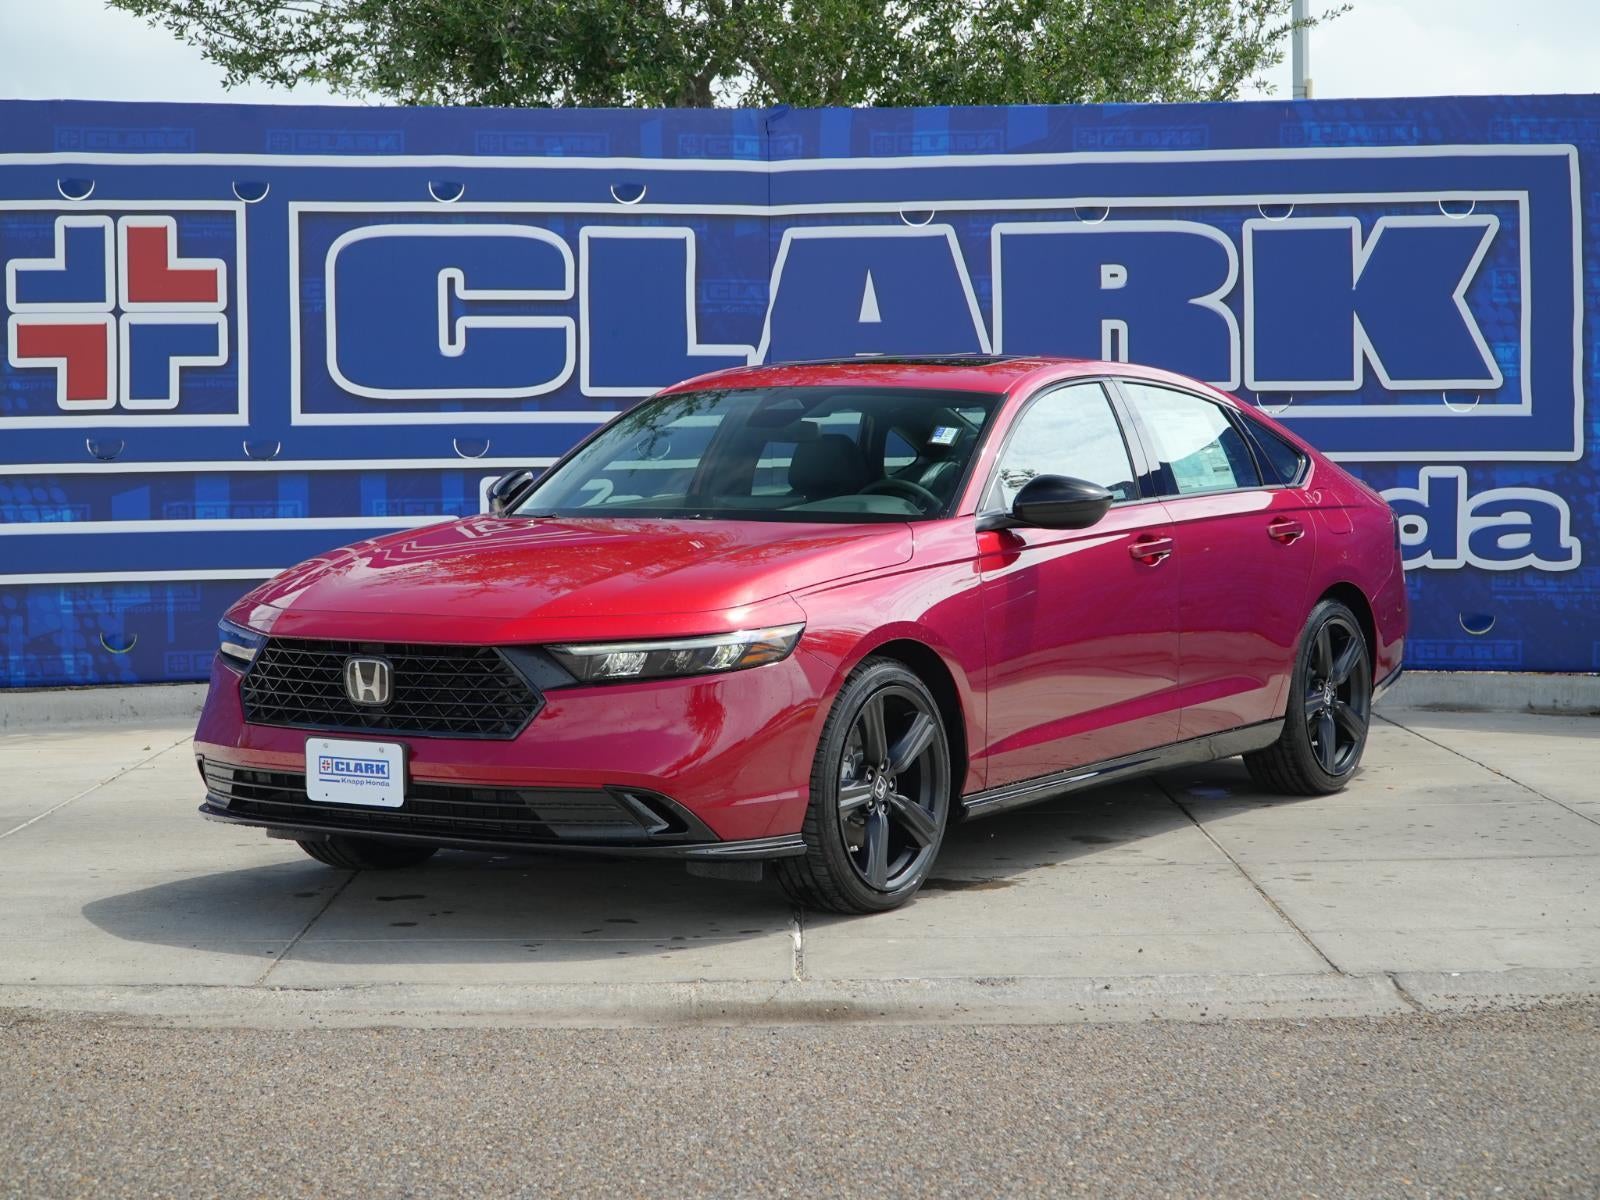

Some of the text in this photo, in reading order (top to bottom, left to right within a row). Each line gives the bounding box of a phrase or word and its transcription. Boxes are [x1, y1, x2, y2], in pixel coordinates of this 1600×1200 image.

[325, 214, 1503, 400] CLARK
[335, 761, 386, 775] CLARK
[340, 778, 390, 787] Knapp Honda
